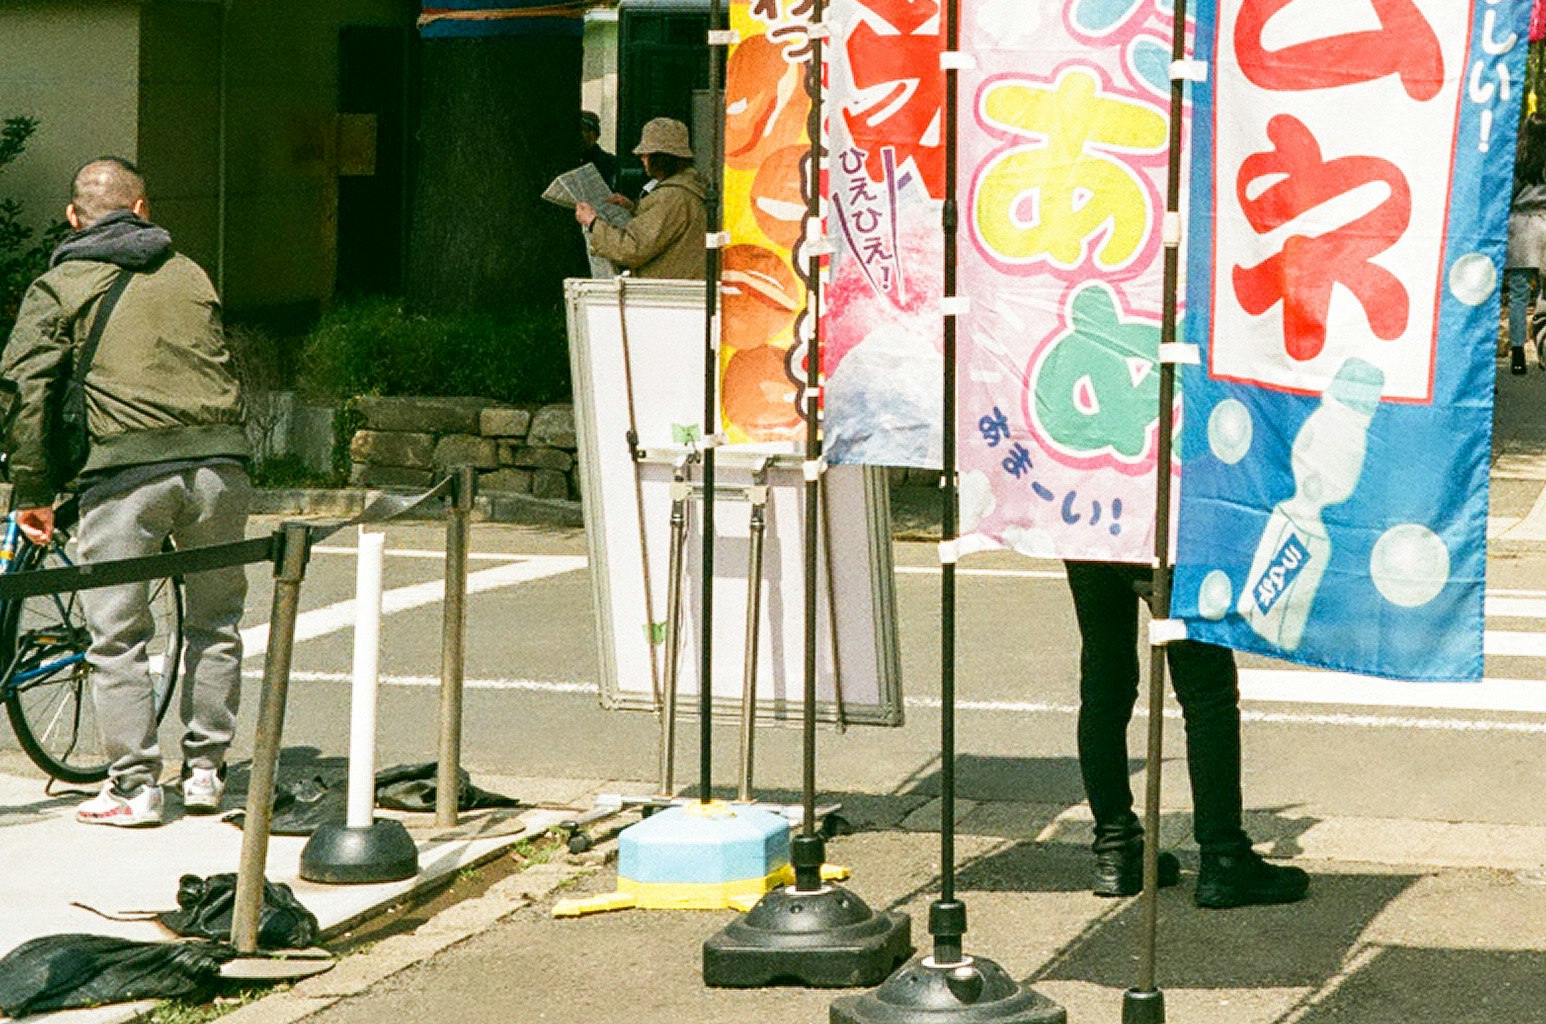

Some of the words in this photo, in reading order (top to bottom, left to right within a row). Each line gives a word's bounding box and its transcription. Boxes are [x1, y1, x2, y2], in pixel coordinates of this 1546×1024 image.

[839, 148, 893, 289] ひえひえ!
[979, 406, 1122, 536] あまーい!
[1258, 544, 1302, 607] ラムネ
